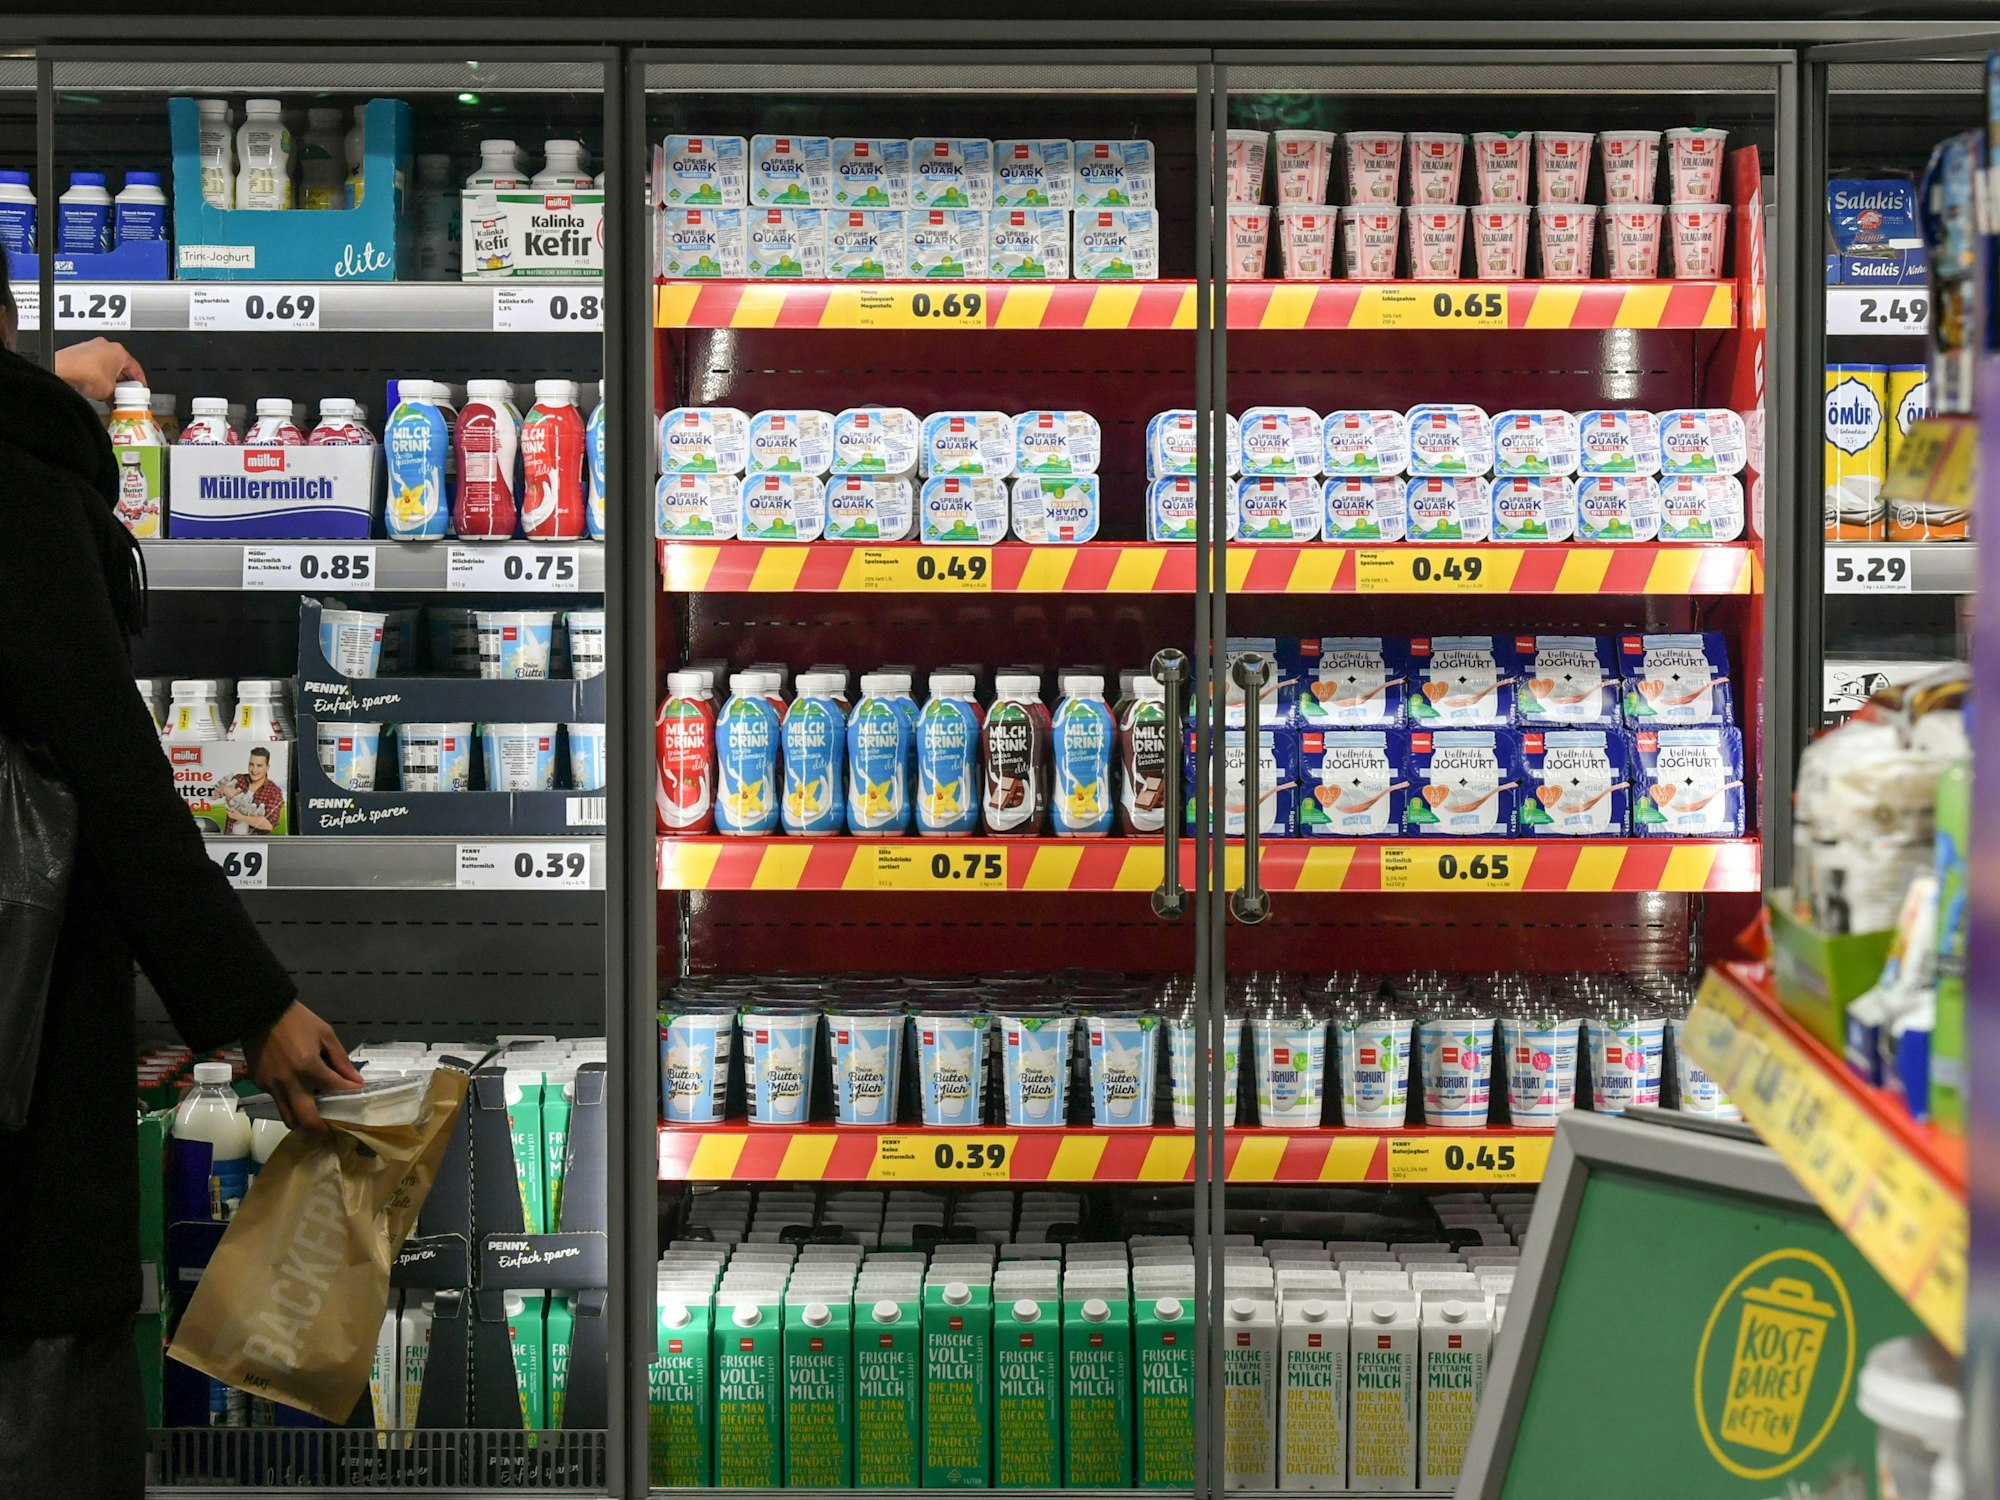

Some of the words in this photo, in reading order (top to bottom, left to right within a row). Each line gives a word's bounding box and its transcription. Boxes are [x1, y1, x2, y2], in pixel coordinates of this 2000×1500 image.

[673, 162, 716, 172] QUARK
[547, 199, 569, 207] müller
[1835, 191, 1904, 210] Salakis
[532, 215, 584, 227] Kalinka
[477, 228, 504, 237] Kalinka
[475, 236, 509, 251] Kefir
[525, 230, 592, 256] Kefir
[673, 234, 715, 244] QUARK
[184, 251, 250, 265] Trink-Joghurt
[335, 242, 390, 277] elite
[1852, 263, 1900, 277] Salakis
[1906, 266, 1927, 276] Natu
[58, 294, 126, 318] 1.29
[246, 295, 314, 319] 0.69
[550, 296, 603, 319] 0.8
[913, 294, 981, 317] 0.69
[1434, 294, 1501, 317] 0.65
[1860, 299, 1928, 323] 2.49
[393, 427, 430, 438] MILCH
[393, 440, 431, 452] DRINK
[1419, 437, 1460, 447] QUARK
[248, 455, 281, 467] müller
[200, 476, 332, 499] Müllermilch
[1246, 500, 1286, 510] QUARK
[1585, 499, 1627, 510] QUARK
[1047, 508, 1088, 517] QUARK
[301, 555, 369, 579] 0.85
[504, 556, 573, 580] 0.75
[918, 557, 986, 580] 0.49
[1413, 558, 1482, 580] 0.49
[1837, 558, 1906, 582] 5.29
[1322, 660, 1381, 669] JOGHURT
[305, 682, 349, 695] PENNY.
[314, 697, 359, 712] Einfach
[362, 692, 400, 709] sparen
[666, 723, 704, 735] MILCH
[989, 726, 1027, 738] MILCH
[1065, 724, 1103, 735] MILCH
[666, 736, 704, 748] DRINK
[989, 740, 1027, 751] DRINK
[1065, 736, 1103, 748] DRINK
[173, 751, 198, 761] müller
[1326, 759, 1385, 769] JOGHURT
[1547, 760, 1605, 770] JOGHURT
[174, 770, 212, 781] eine
[176, 786, 215, 796] utter
[309, 798, 354, 809] PENNY.
[320, 809, 367, 828] Einfach
[369, 805, 408, 821] sparen
[224, 852, 262, 876] 69
[515, 853, 584, 877] 0.39
[932, 855, 1001, 878] 0.75
[1438, 855, 1508, 879] 0.65
[667, 1069, 701, 1080] Butter
[1267, 1071, 1298, 1082] JOGHURT
[669, 1081, 699, 1091] Milch
[1436, 1077, 1467, 1088] JOGHURT
[1601, 1077, 1632, 1088] JOGHURT
[935, 1144, 1005, 1169] 0.39
[1445, 1146, 1514, 1171] 0.45
[488, 1241, 530, 1251] PENNY.
[400, 1251, 436, 1265] sparen
[499, 1252, 541, 1268] Einfach
[544, 1248, 580, 1263] sparen
[1742, 1316, 1815, 1365] KOST-
[721, 1355, 765, 1367] FRISCHE
[1288, 1351, 1332, 1362] FRISCHE
[1428, 1353, 1472, 1364] FRISCHE
[1287, 1363, 1332, 1372] FETTARME
[1428, 1364, 1473, 1373] FETTARME
[720, 1368, 765, 1384] VOLL-
[1288, 1372, 1332, 1387] MILCH
[1428, 1373, 1472, 1388] MILCH
[1735, 1364, 1807, 1401] BARES
[720, 1384, 765, 1400] MILCH
[1287, 1390, 1304, 1400] DIE
[1308, 1390, 1332, 1400] MAN
[1286, 1421, 1336, 1430] GENIESSEN
[1727, 1406, 1795, 1437] RETTEN
[1286, 1444, 1340, 1456] MINDEST-
[1286, 1464, 1339, 1476] DATUMS.
